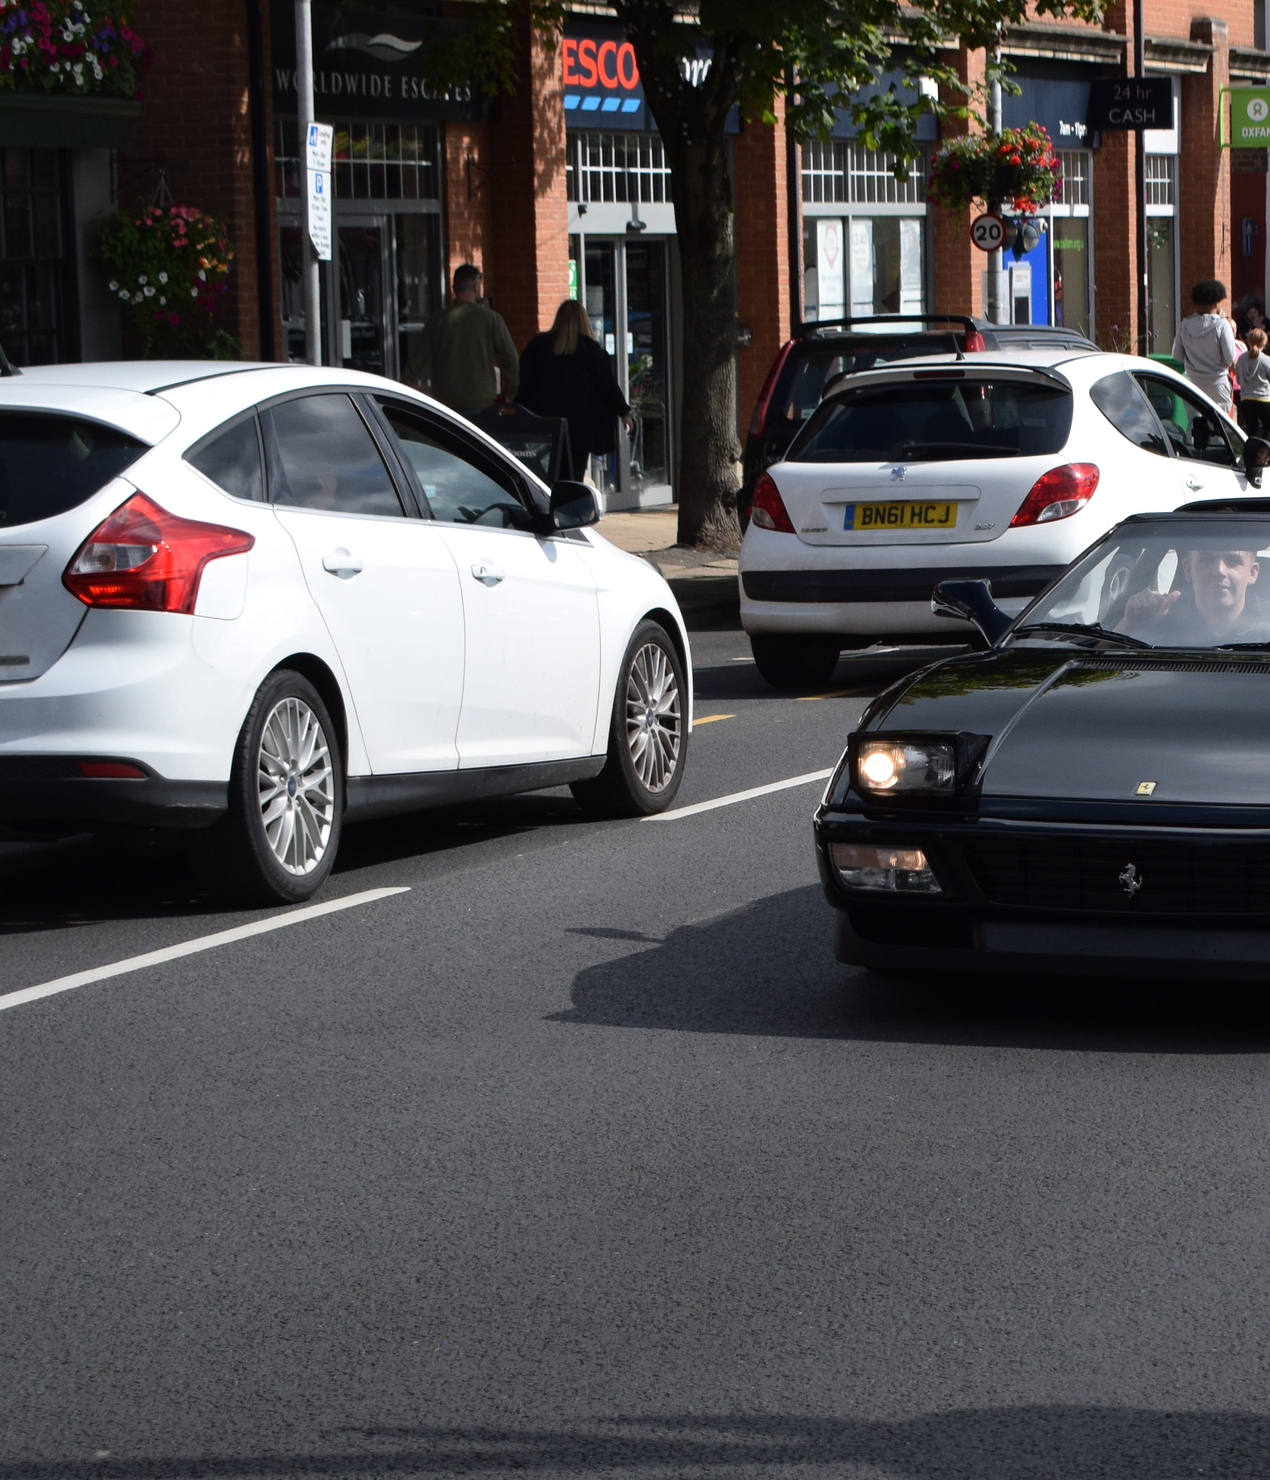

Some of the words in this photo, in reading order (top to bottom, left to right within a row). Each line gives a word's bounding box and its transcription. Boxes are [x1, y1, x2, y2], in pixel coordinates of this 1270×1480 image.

[1113, 85, 1131, 100] 24
[1136, 85, 1153, 99] hr
[1109, 108, 1156, 124] CASH
[976, 224, 1001, 241] 20
[861, 505, 906, 526] BN61
[910, 505, 950, 524] HCJ
[974, 523, 996, 531] 207
